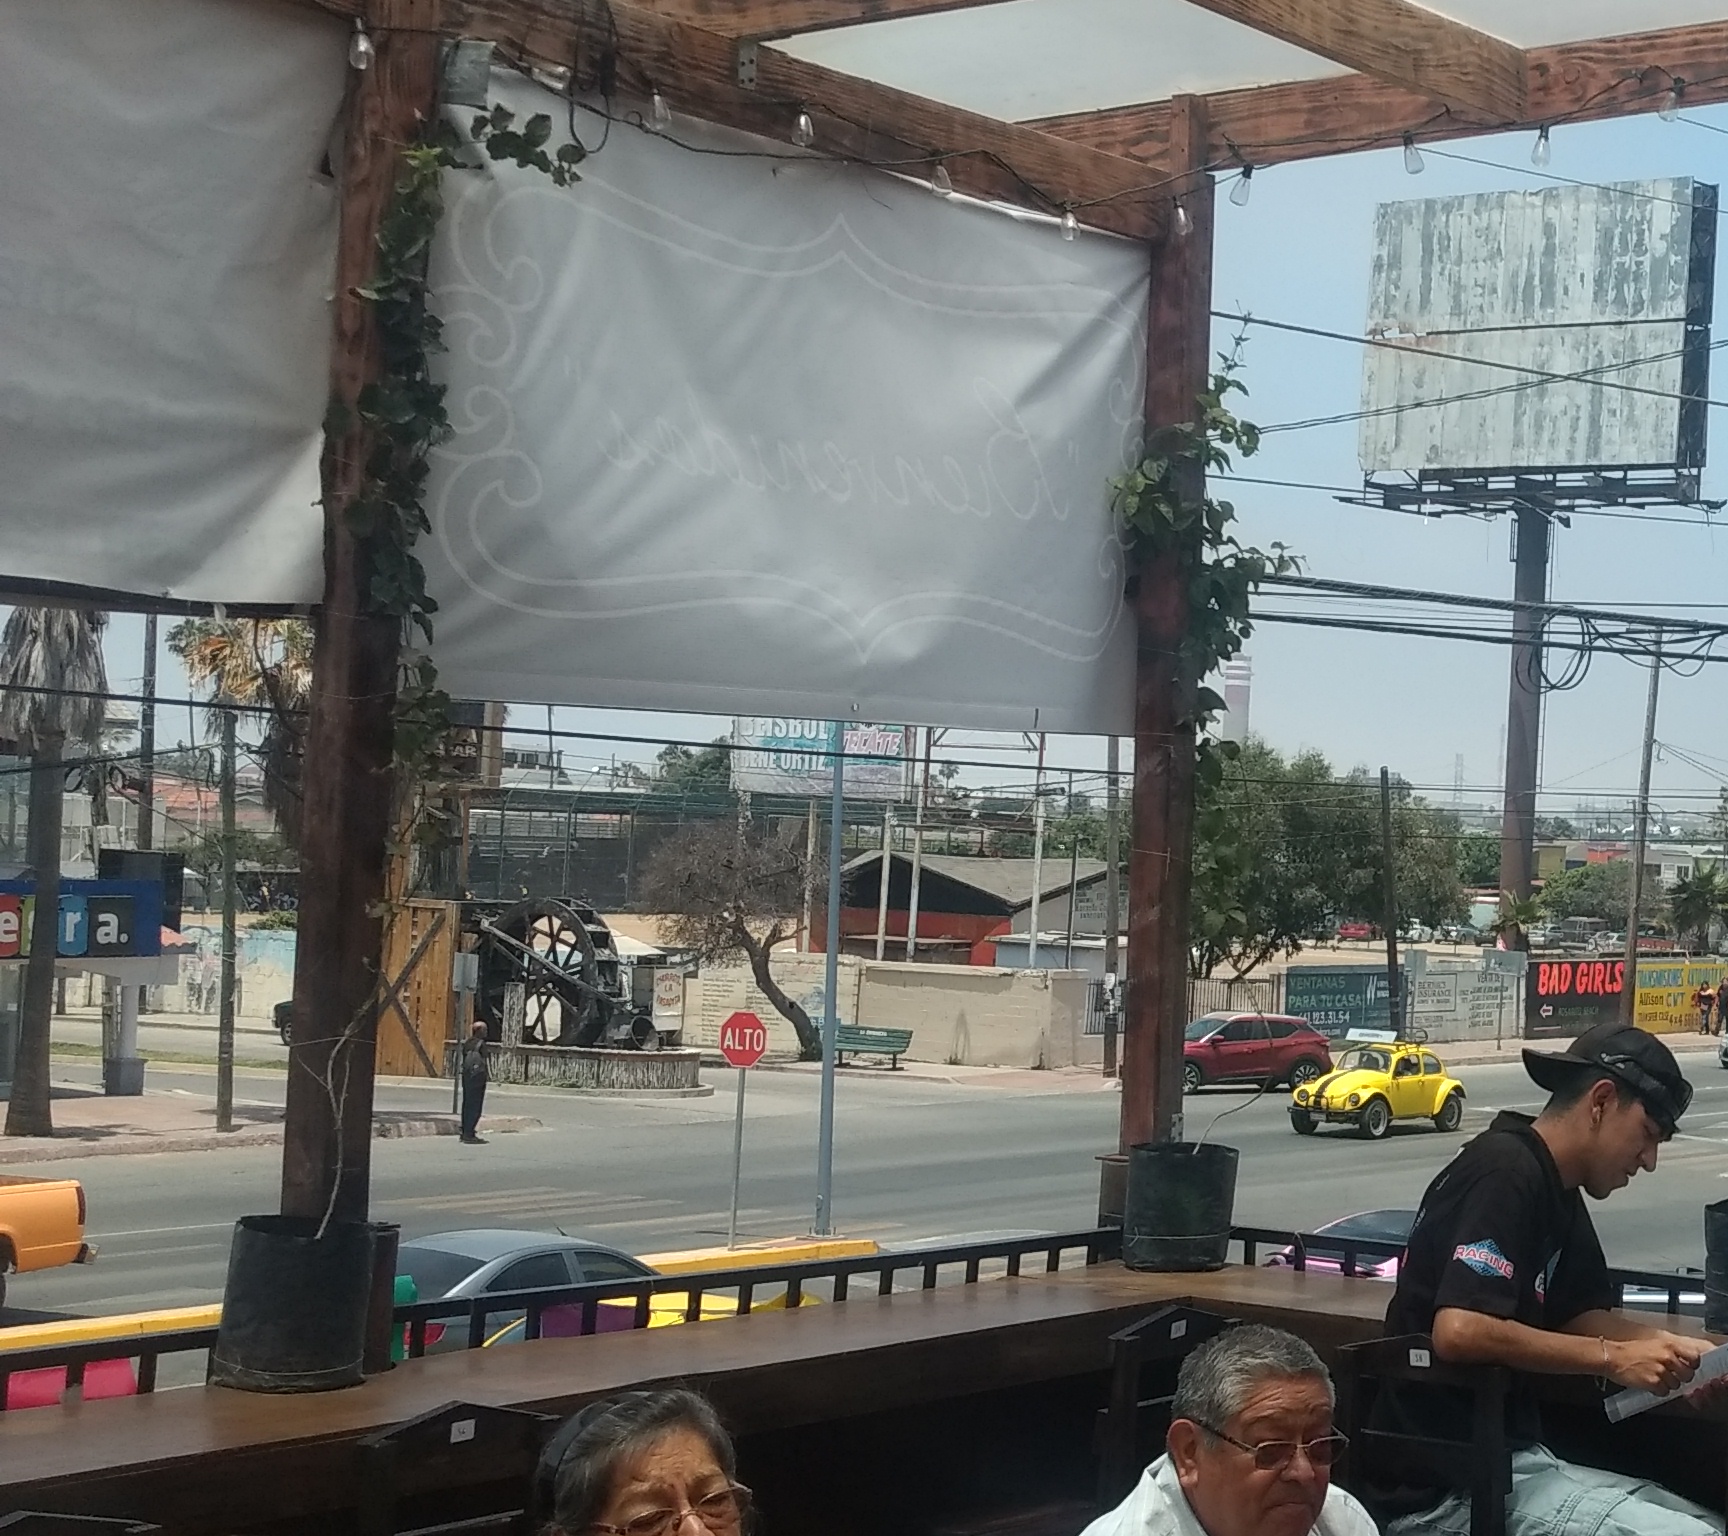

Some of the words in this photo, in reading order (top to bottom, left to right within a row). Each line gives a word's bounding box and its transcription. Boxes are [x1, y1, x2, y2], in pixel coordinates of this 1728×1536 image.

[1290, 976, 1346, 990] VENTANAS
[1537, 963, 1572, 996] BAD
[1575, 961, 1625, 996] GIRLS
[1288, 994, 1317, 1008] PARA
[1321, 995, 1333, 1007] TU
[1335, 994, 1362, 1007] CASA
[1639, 993, 1663, 1006] Allison
[723, 1027, 764, 1052] ALTO
[1453, 1244, 1514, 1280] RACING
